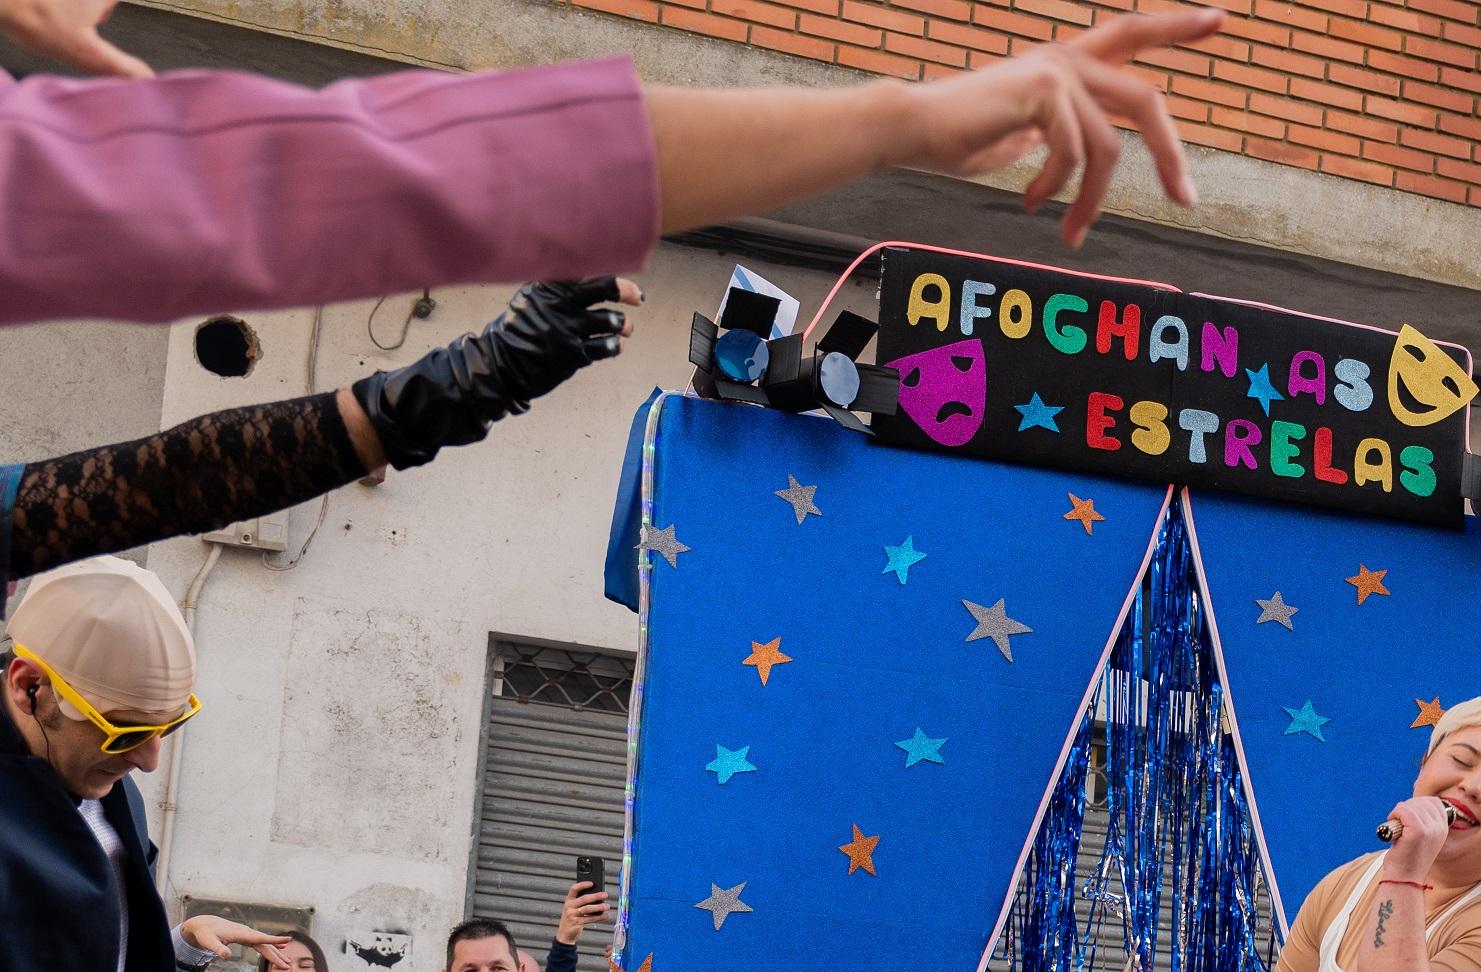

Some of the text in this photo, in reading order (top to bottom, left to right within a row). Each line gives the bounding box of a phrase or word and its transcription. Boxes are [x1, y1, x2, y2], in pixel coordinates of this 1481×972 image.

[907, 272, 1374, 413] AFOGHAN AS
[1086, 391, 1437, 498] ESTRELAS
